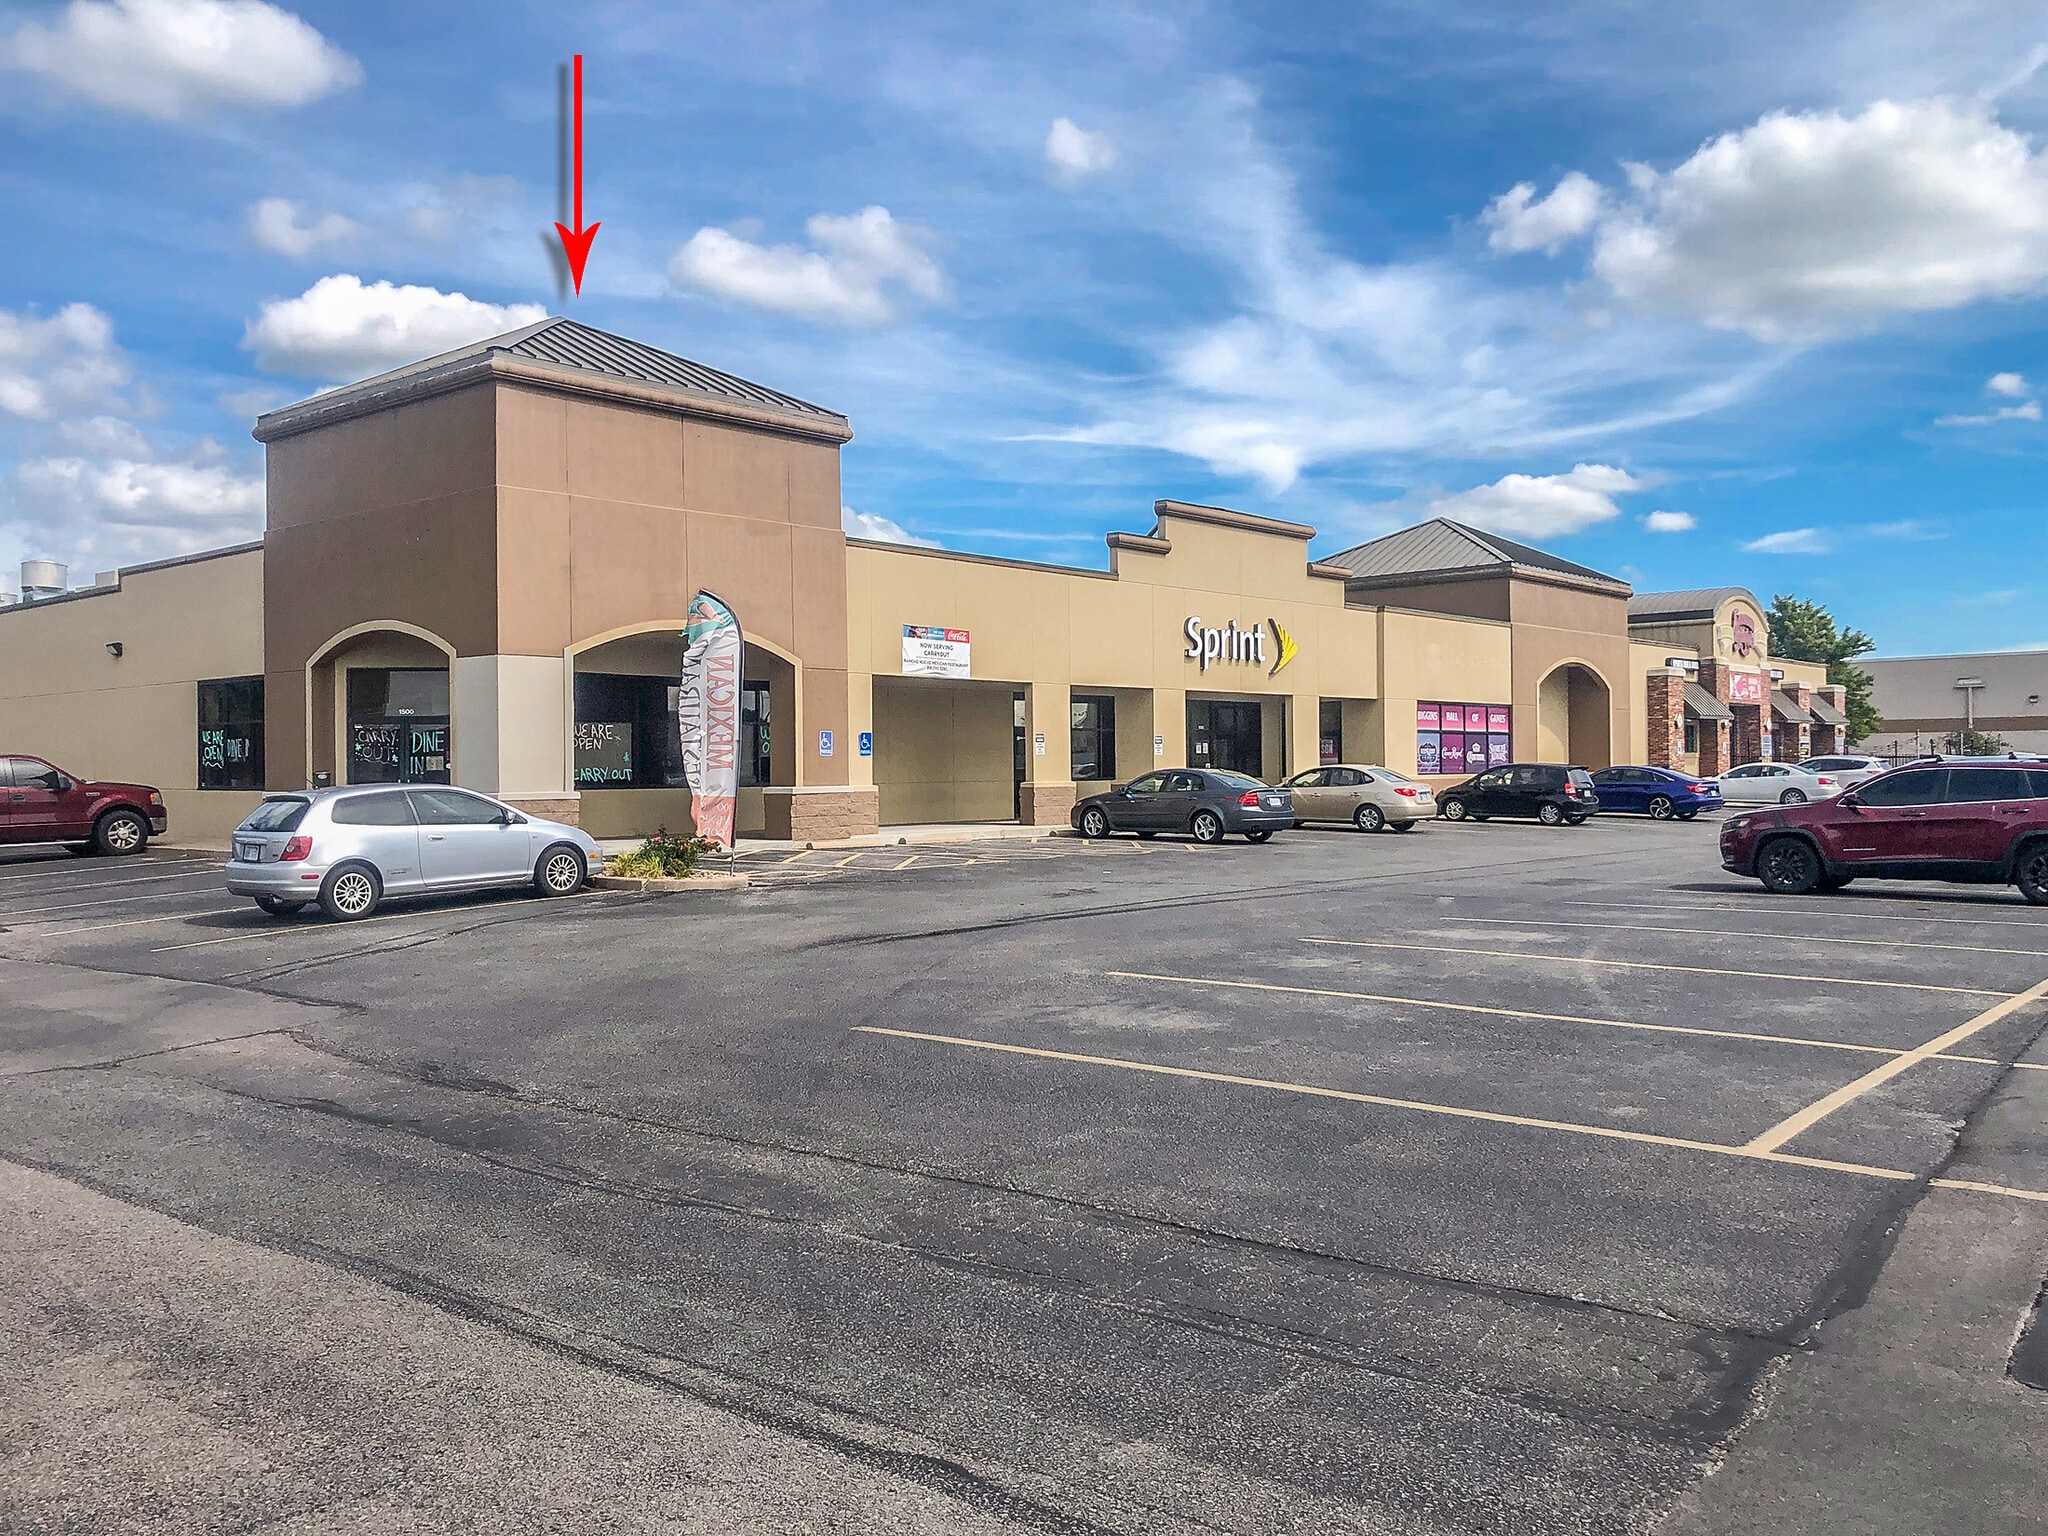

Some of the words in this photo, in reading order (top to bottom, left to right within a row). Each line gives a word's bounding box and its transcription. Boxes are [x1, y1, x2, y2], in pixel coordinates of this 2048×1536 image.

[1184, 616, 1266, 671] Sprint
[1472, 713, 1479, 722] OF
[202, 730, 212, 745] WE
[212, 730, 224, 746] ARE
[358, 730, 397, 746] CARRY
[591, 725, 614, 740] ARE
[227, 739, 243, 758] DINE
[412, 731, 445, 753] DINE
[204, 745, 224, 761] OPEN
[362, 747, 395, 761] OUT
[410, 756, 424, 775] IN
[611, 769, 632, 781] OUT
